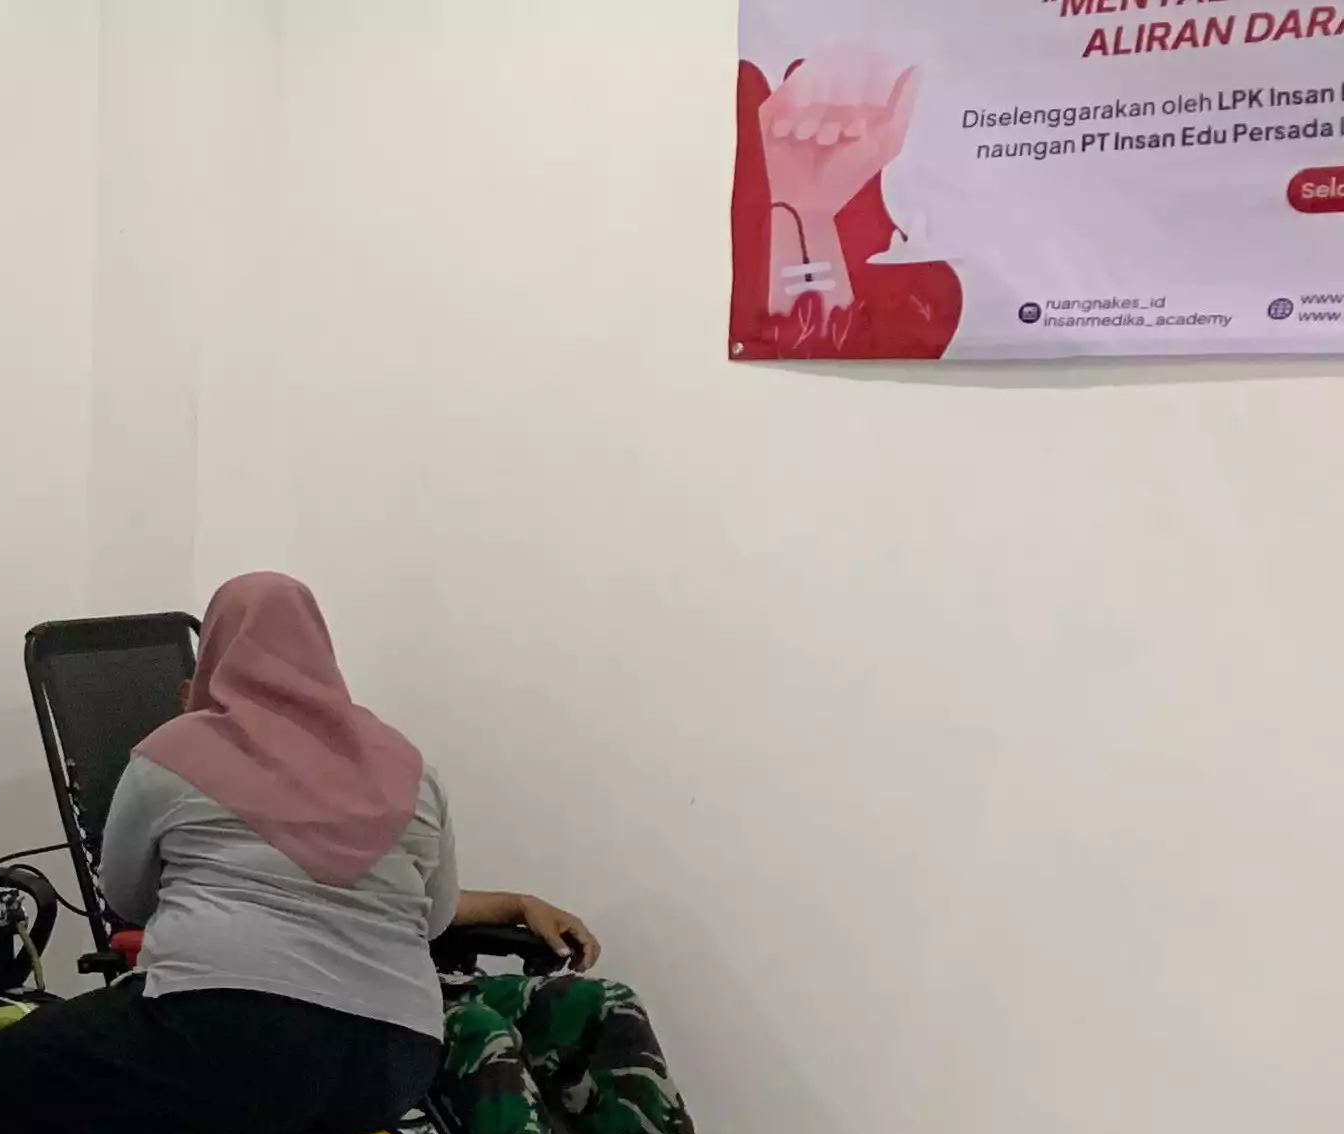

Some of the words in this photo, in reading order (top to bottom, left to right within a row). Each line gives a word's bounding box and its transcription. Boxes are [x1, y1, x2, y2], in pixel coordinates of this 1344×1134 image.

[1082, 16, 1235, 57] ALIRAN
[961, 100, 1155, 130] Diselenggarakan
[1162, 93, 1212, 115] oleh
[1218, 88, 1264, 112] LPK
[1269, 82, 1334, 107] Insan
[976, 138, 1076, 160] naungan
[1081, 132, 1110, 152] PT
[1114, 128, 1175, 151] Insan
[1181, 124, 1227, 147] Edu
[1233, 117, 1334, 144] Persada
